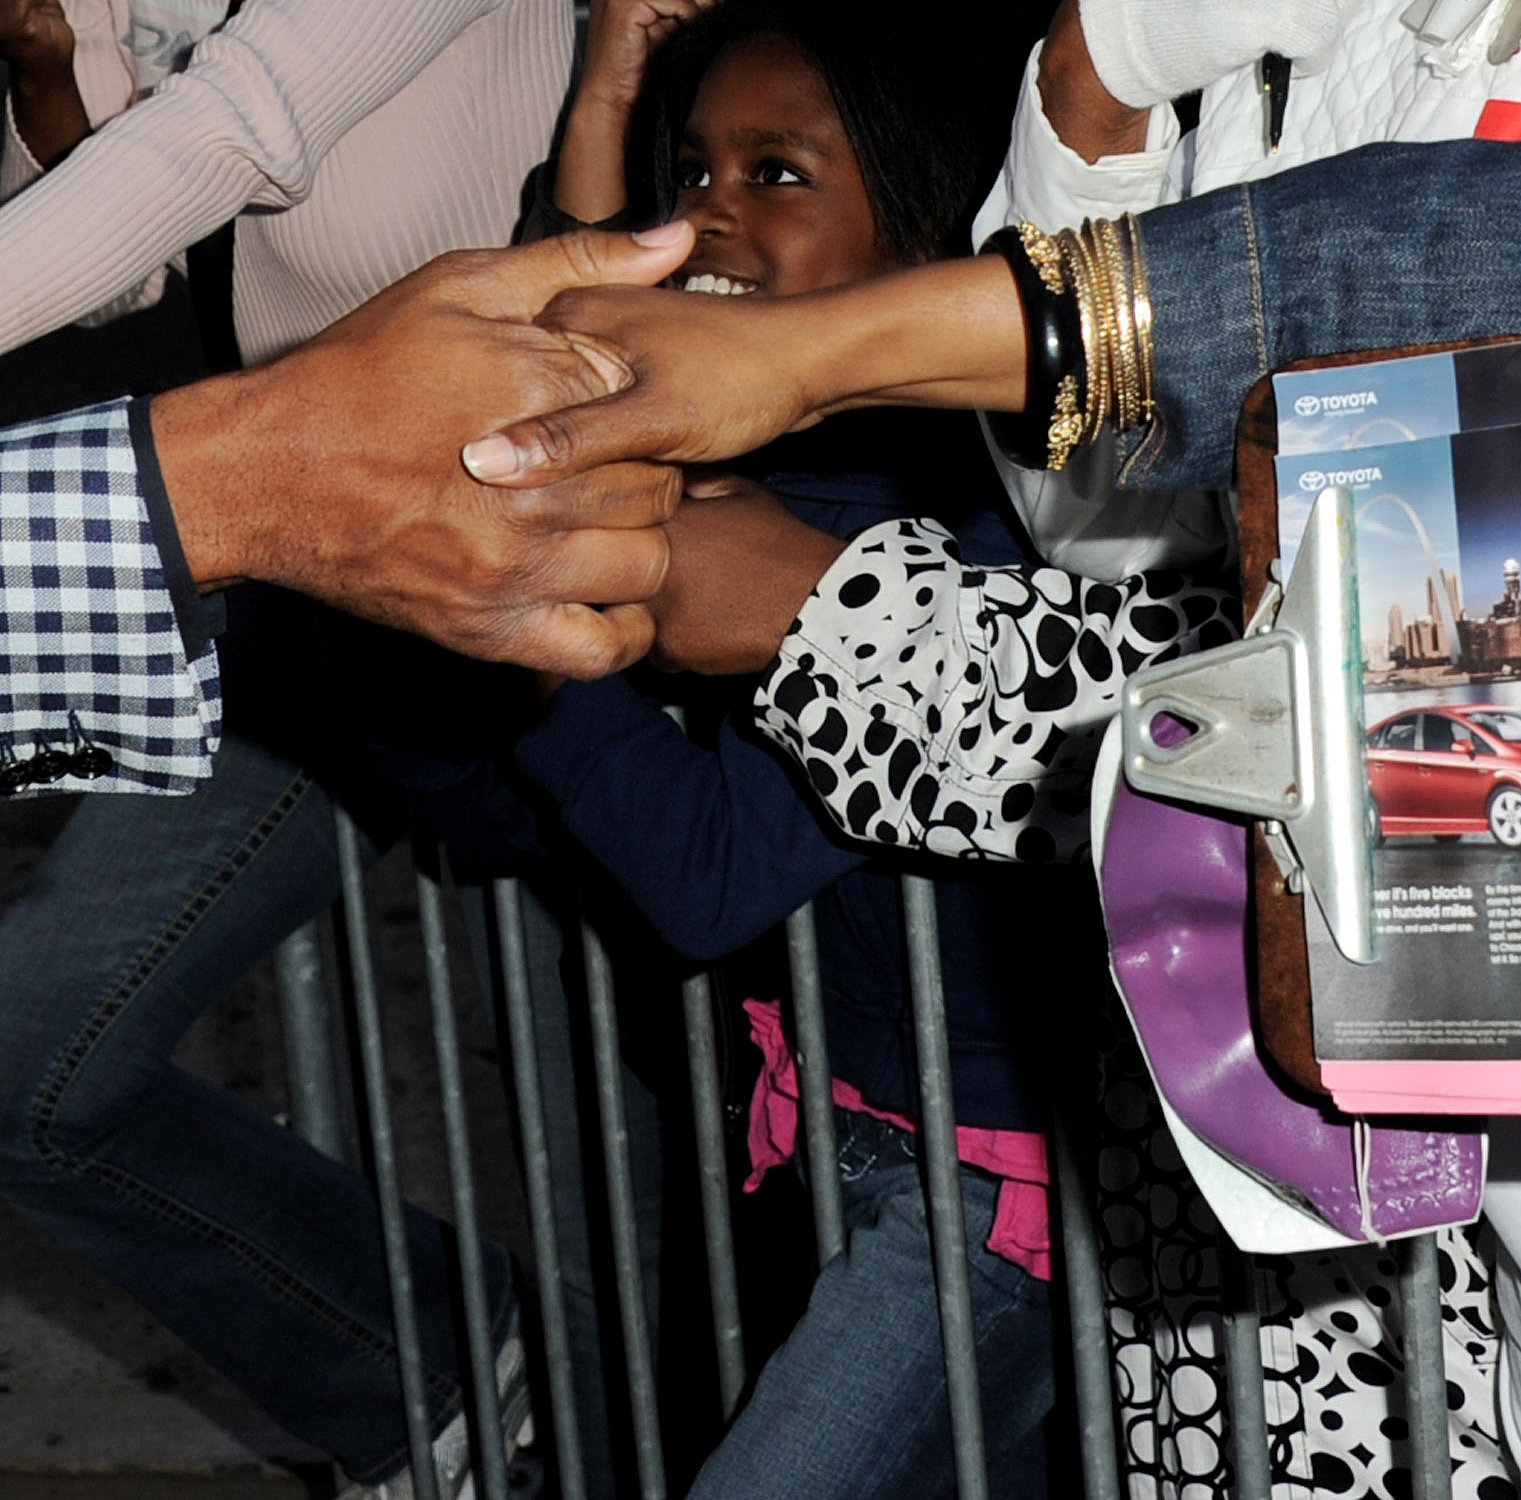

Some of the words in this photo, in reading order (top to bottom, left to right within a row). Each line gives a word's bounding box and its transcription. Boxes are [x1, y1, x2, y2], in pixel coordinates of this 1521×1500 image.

[1321, 391, 1378, 410] TOYOTA
[1327, 467, 1382, 485] TOYOTA
[1374, 889, 1390, 901] er
[1392, 886, 1408, 901] it's
[1409, 886, 1431, 901] five
[1431, 885, 1473, 900] blocks
[1375, 908, 1392, 919] ve
[1392, 904, 1440, 919] hundred
[1441, 903, 1478, 918] miles.
